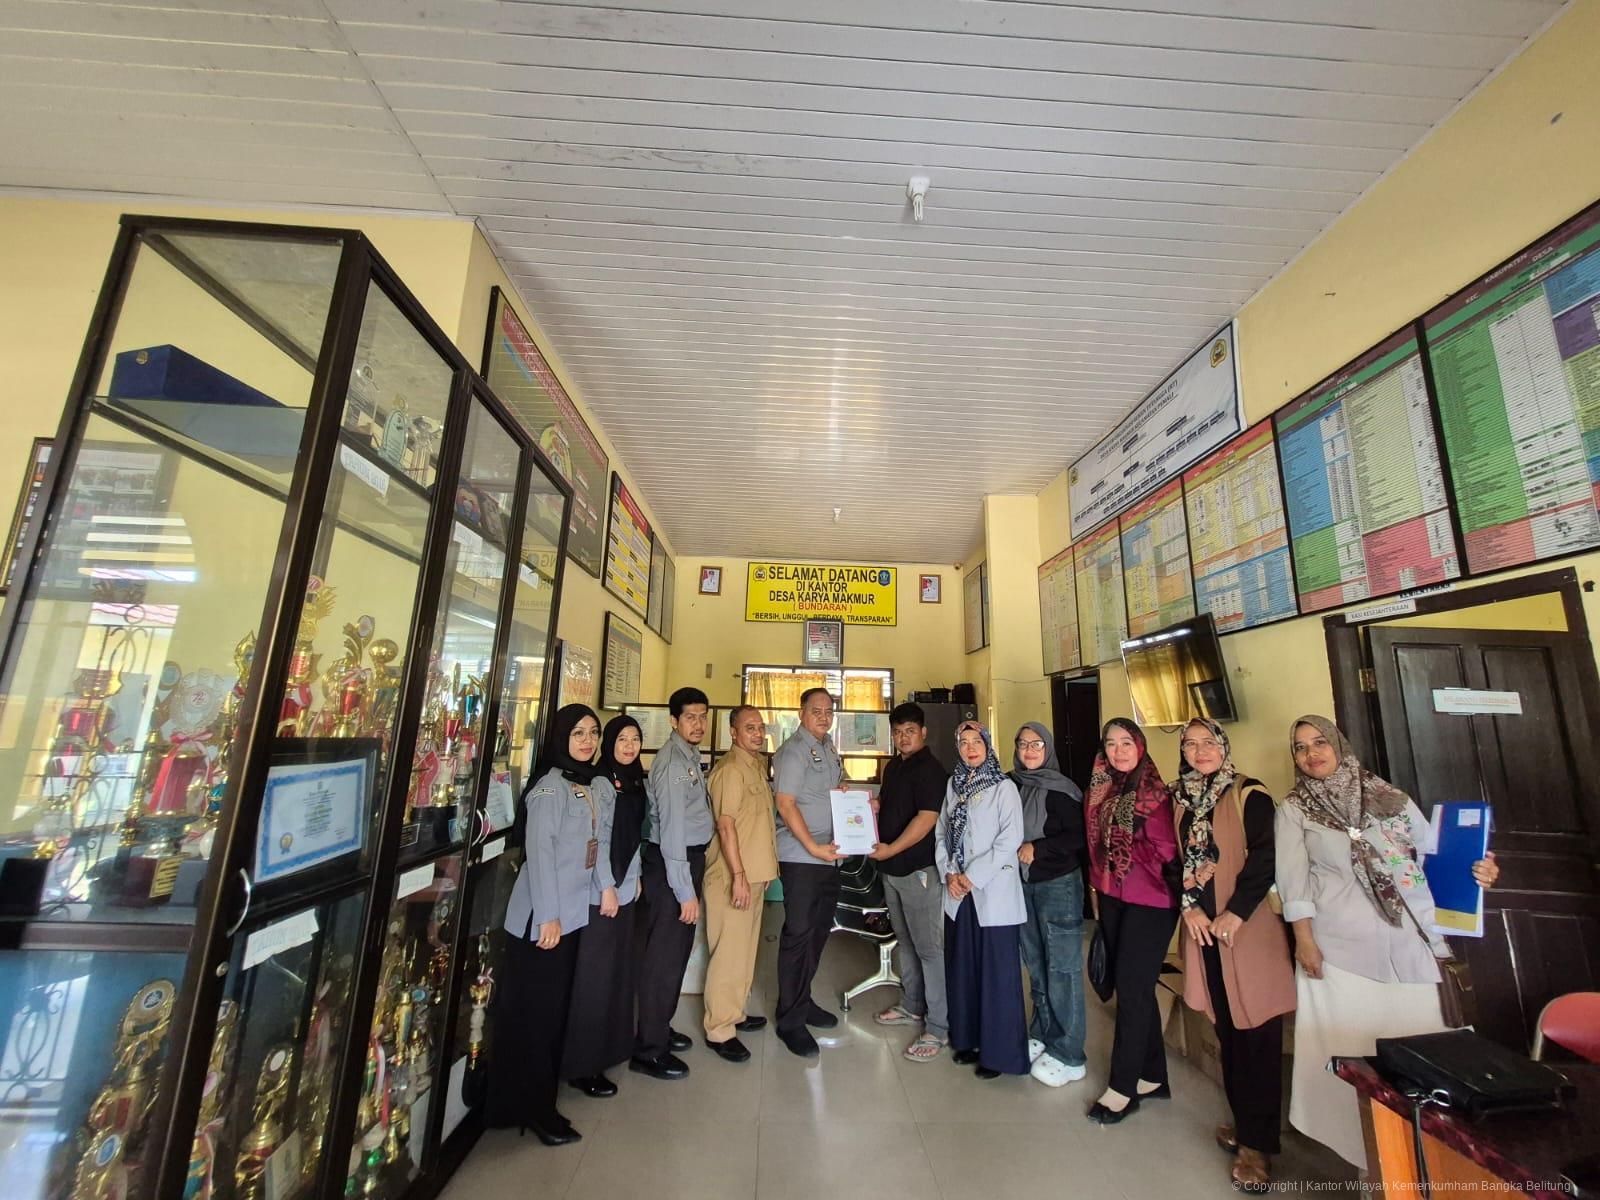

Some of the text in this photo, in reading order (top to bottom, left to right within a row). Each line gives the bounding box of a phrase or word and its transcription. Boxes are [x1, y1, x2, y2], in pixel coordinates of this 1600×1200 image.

[769, 566, 877, 583] SELAMAT DATANG
[796, 581, 848, 593] DI KANTOR
[769, 590, 875, 605] DESA KARYA MAKMUR
[799, 602, 848, 611] BUNDARAN
